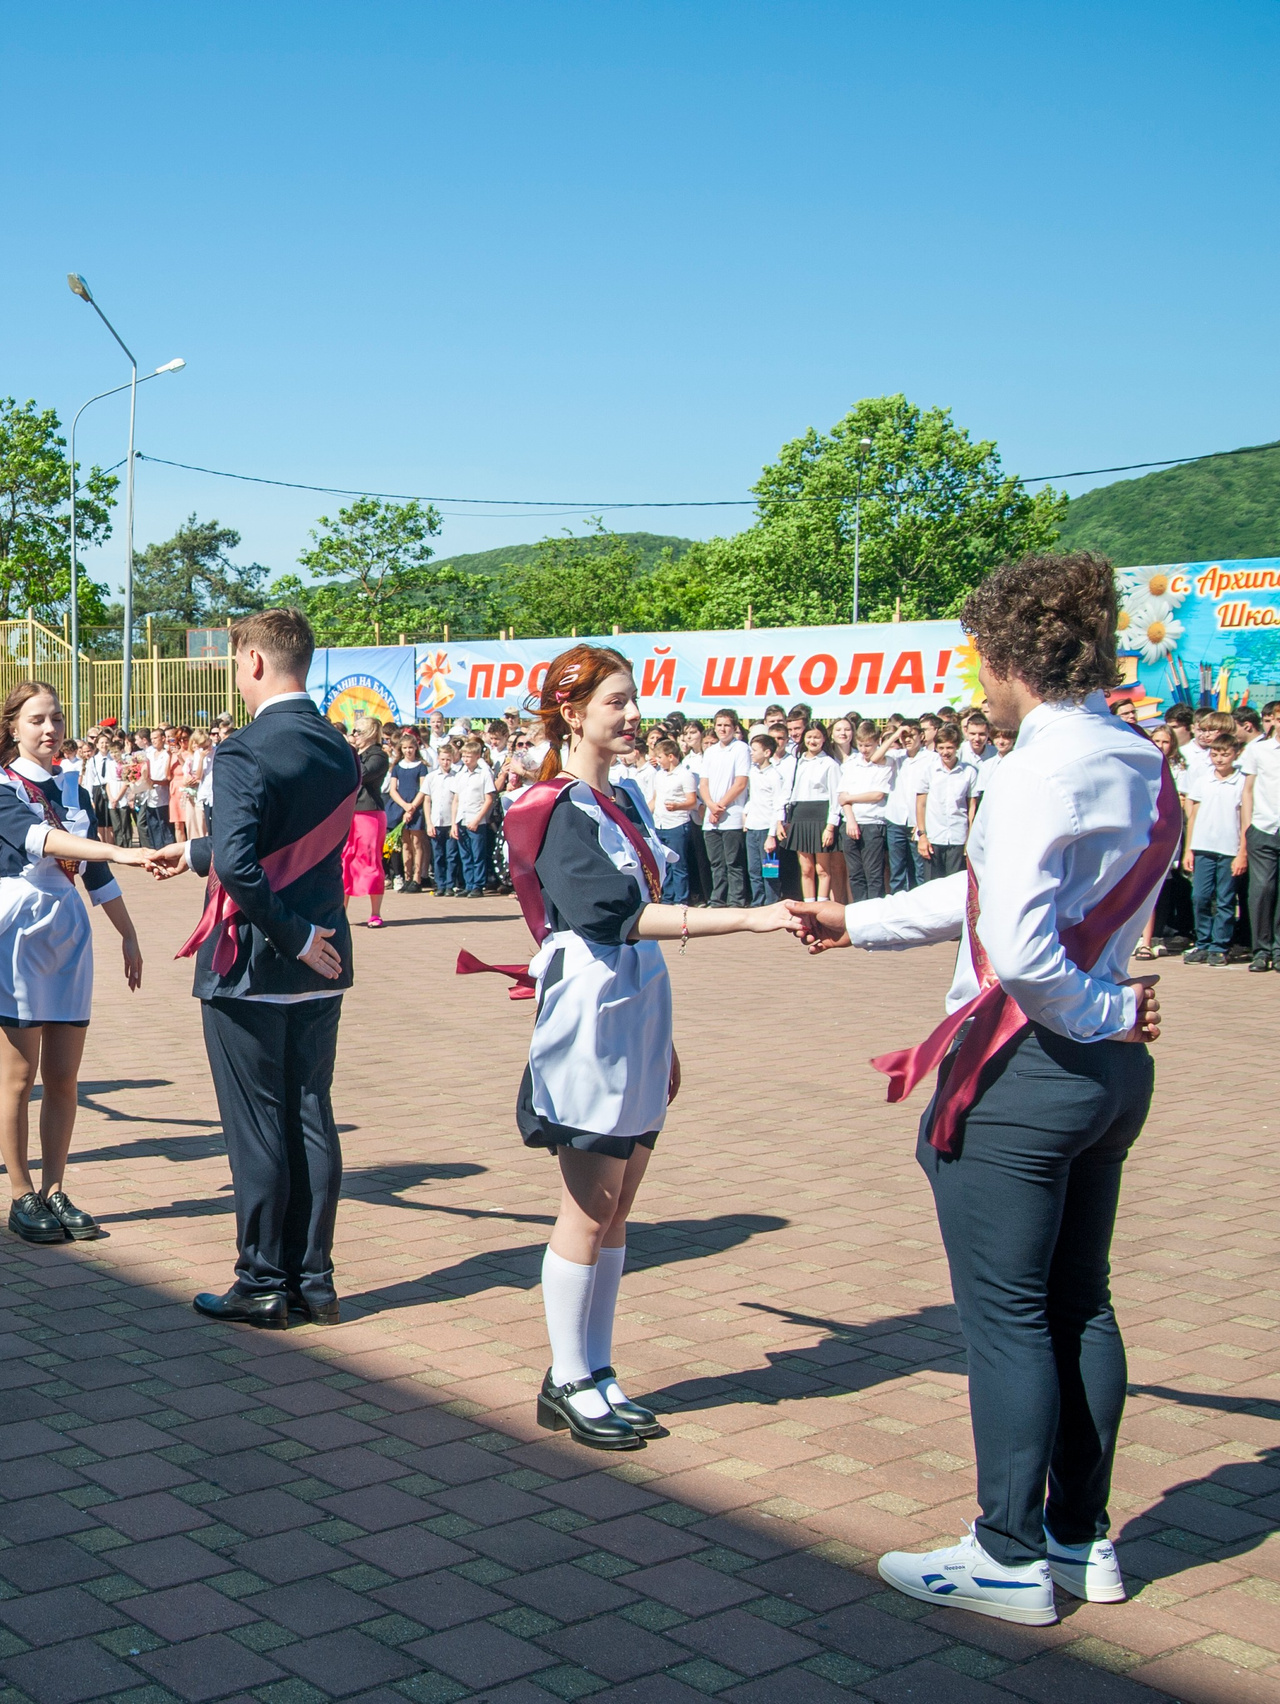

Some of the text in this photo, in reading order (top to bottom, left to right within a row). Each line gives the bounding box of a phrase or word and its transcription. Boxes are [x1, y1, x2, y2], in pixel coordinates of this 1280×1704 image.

[1198, 567, 1280, 598] Архип
[359, 676, 371, 688] НА
[701, 650, 952, 696] ШКОЛА!
